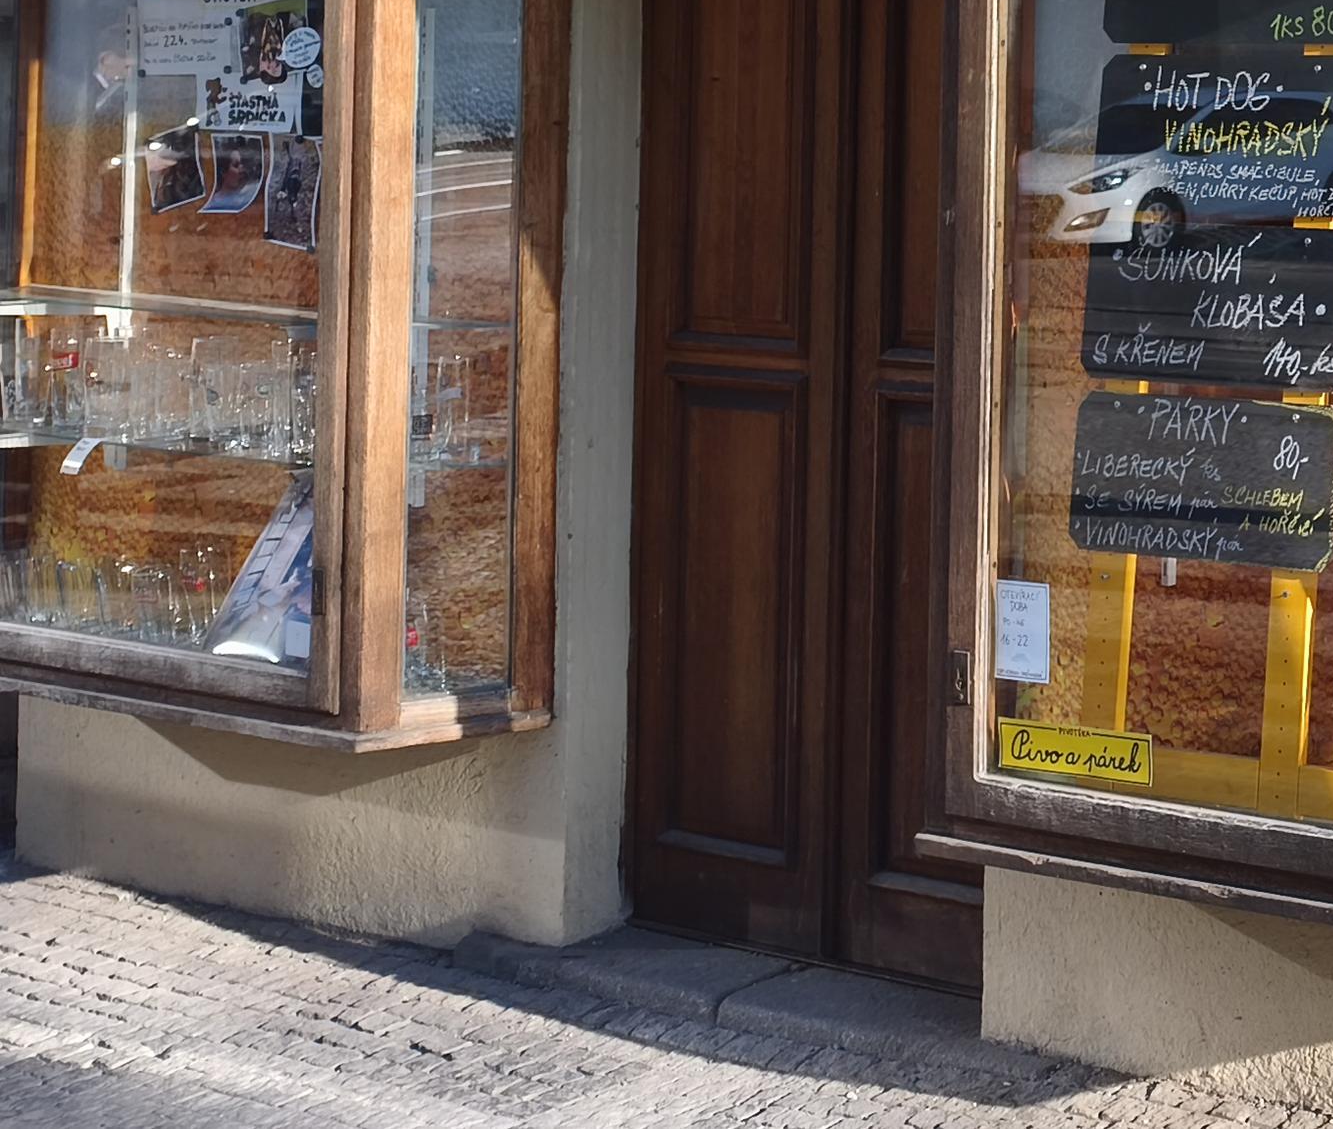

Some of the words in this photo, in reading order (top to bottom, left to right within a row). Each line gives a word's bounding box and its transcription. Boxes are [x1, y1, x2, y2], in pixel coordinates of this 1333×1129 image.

[1153, 65, 1210, 112] HOT
[1213, 70, 1271, 112] DOG
[1164, 96, 1332, 162] VINOHRADSKÝ
[1200, 178, 1249, 200] CURRY
[1300, 187, 1328, 203] HOT
[1114, 322, 1206, 372] KŘENEM
[1147, 397, 1240, 448] PÁRKY
[1080, 446, 1196, 487] LIBERECKÝ
[1118, 482, 1183, 516] SÝREM
[1085, 516, 1218, 557] VINOHRADSKÝ
[1010, 729, 1064, 764] Pivo
[1065, 751, 1082, 766] a
[1083, 741, 1142, 774] párek
